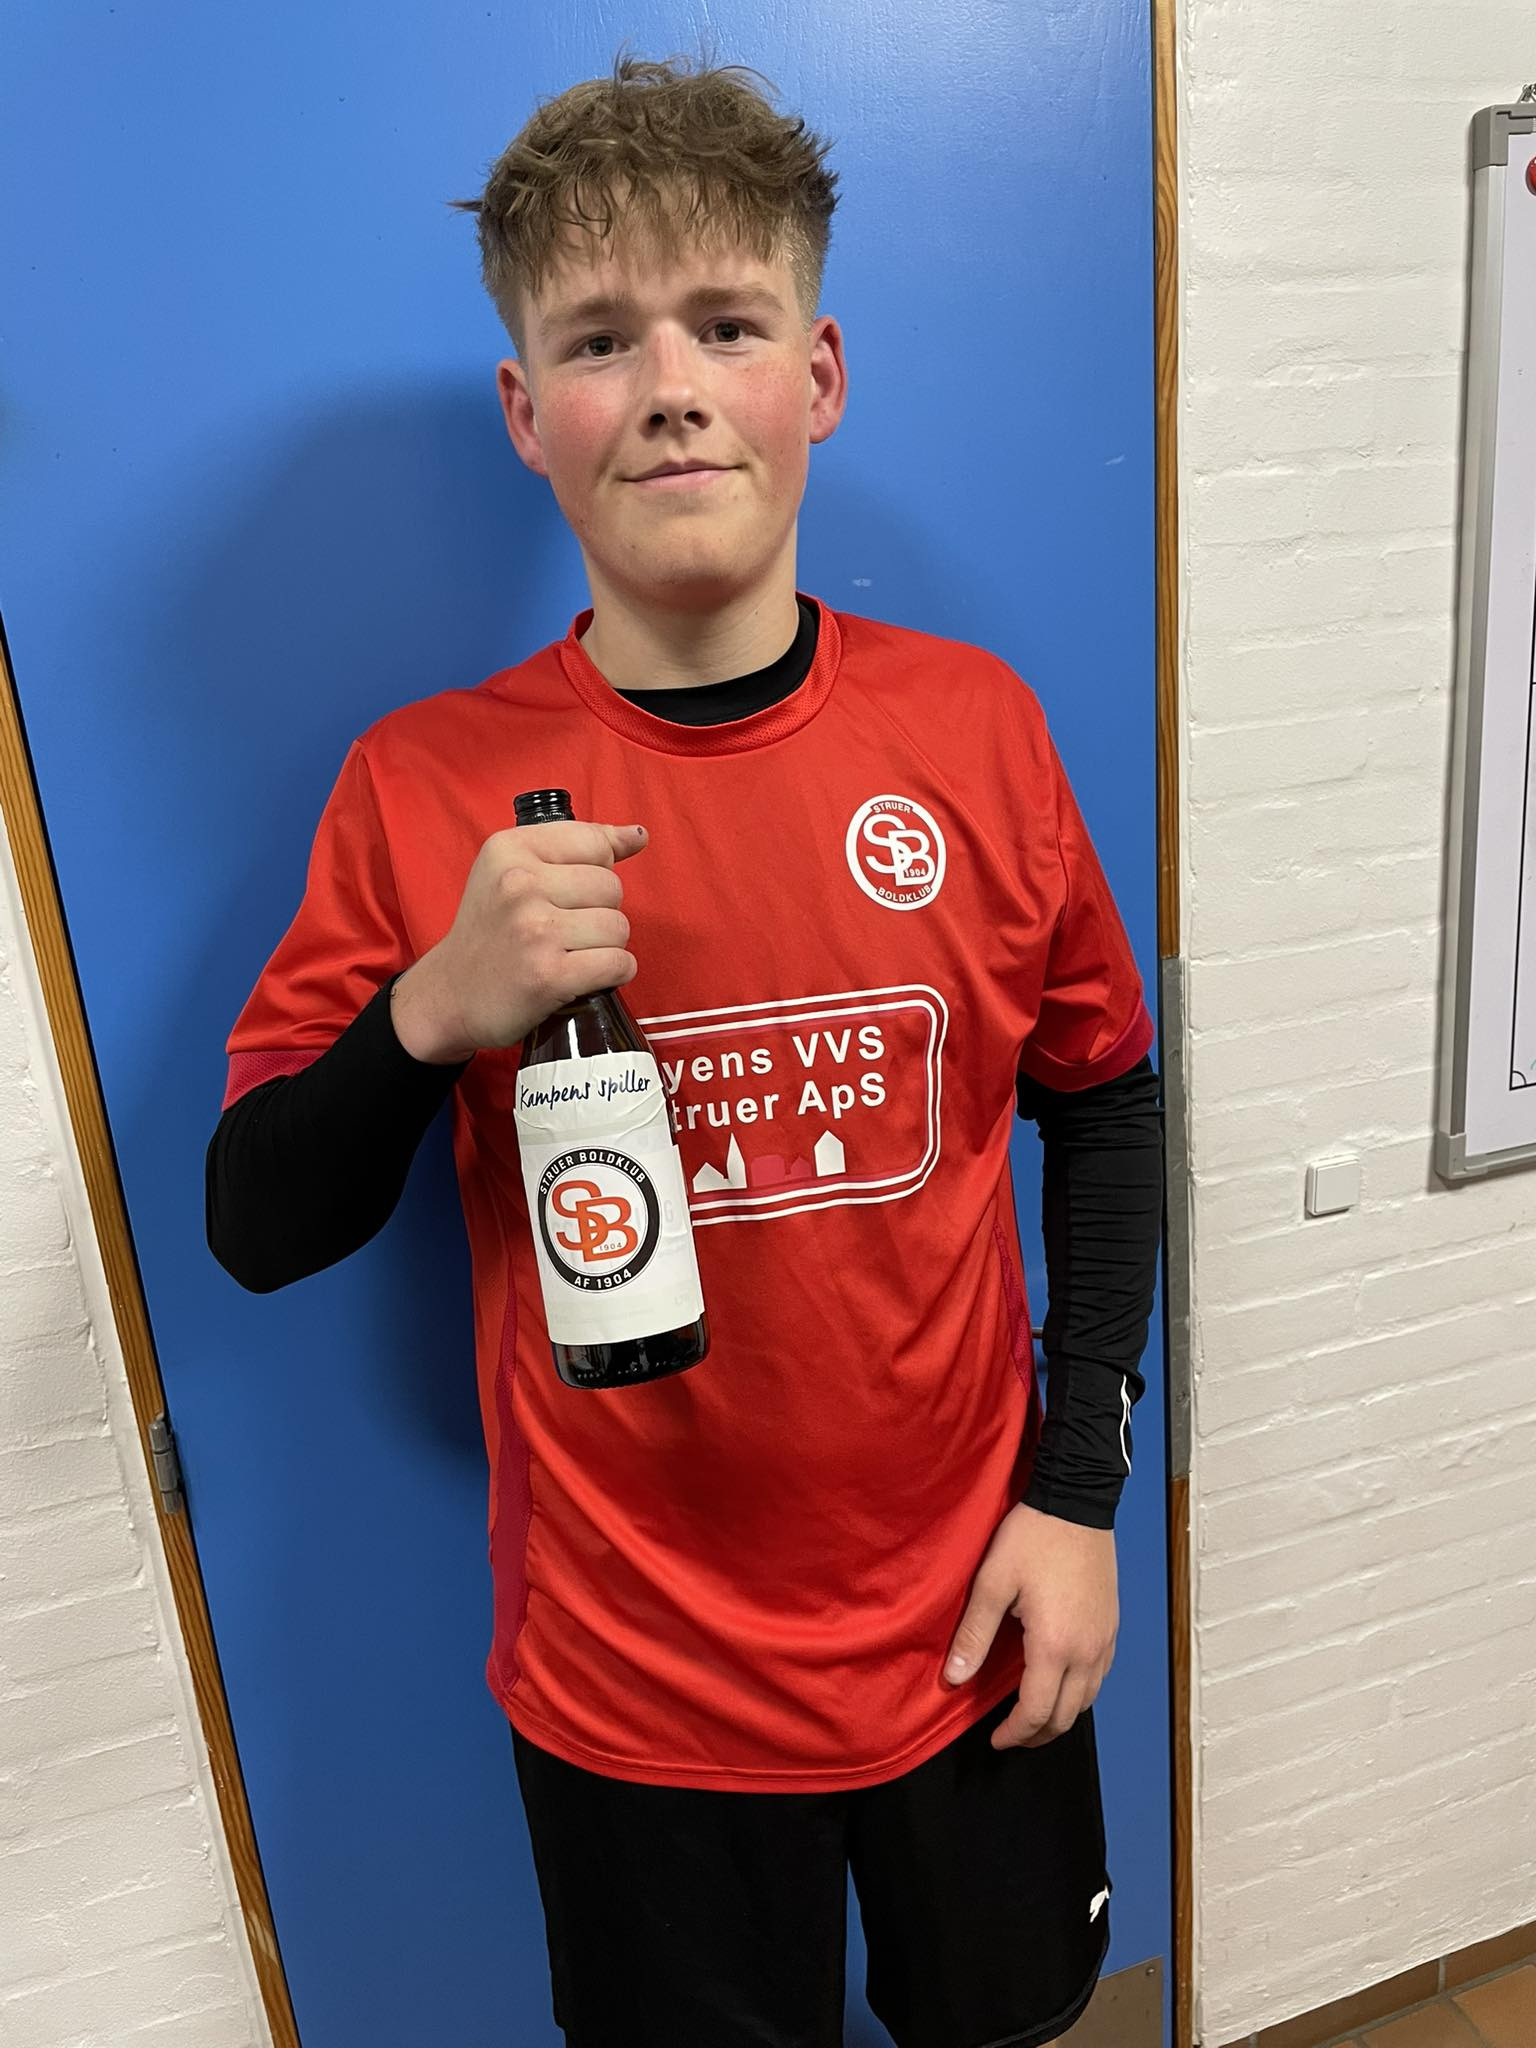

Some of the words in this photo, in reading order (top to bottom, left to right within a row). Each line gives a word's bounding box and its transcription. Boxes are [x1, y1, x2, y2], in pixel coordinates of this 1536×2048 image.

[873, 801, 911, 813] STRUER
[905, 868, 926, 877] 1904
[878, 885, 931, 902] BOLDKLUB
[661, 1048, 773, 1095] yens
[792, 1026, 885, 1068] VVS
[598, 1069, 651, 1101] spiller
[671, 1094, 779, 1131] truer
[797, 1072, 886, 1119] ApS
[540, 1156, 575, 1195] STRUER
[579, 1151, 646, 1183] BOLDKLUB
[600, 1242, 622, 1251] 1904
[574, 1275, 591, 1288] AF
[596, 1268, 632, 1289] 1904
